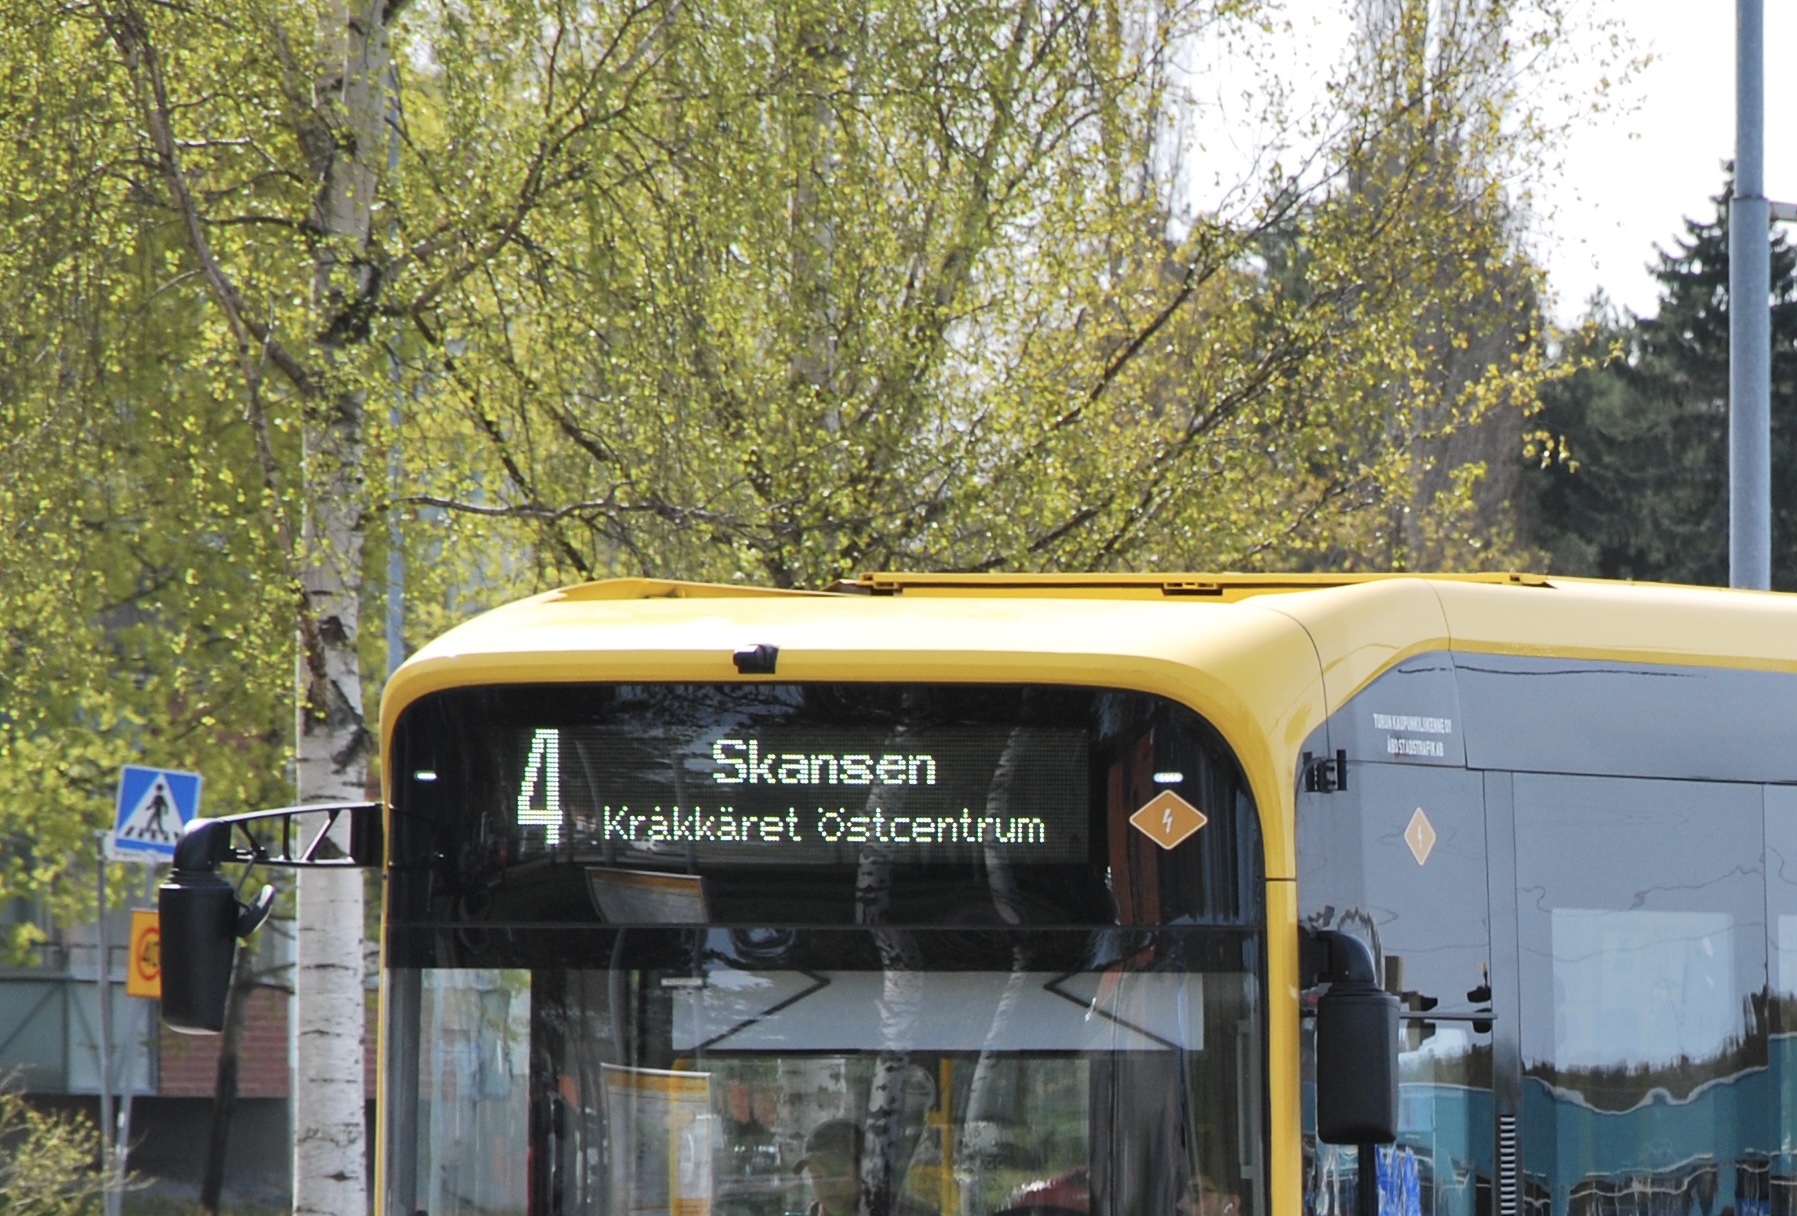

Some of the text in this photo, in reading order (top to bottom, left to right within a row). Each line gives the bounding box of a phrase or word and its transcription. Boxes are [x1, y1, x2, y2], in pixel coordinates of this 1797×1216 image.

[712, 739, 936, 784] Skansen
[517, 728, 563, 845] 4
[604, 805, 1046, 842] Kråkkäret Östcentrum
